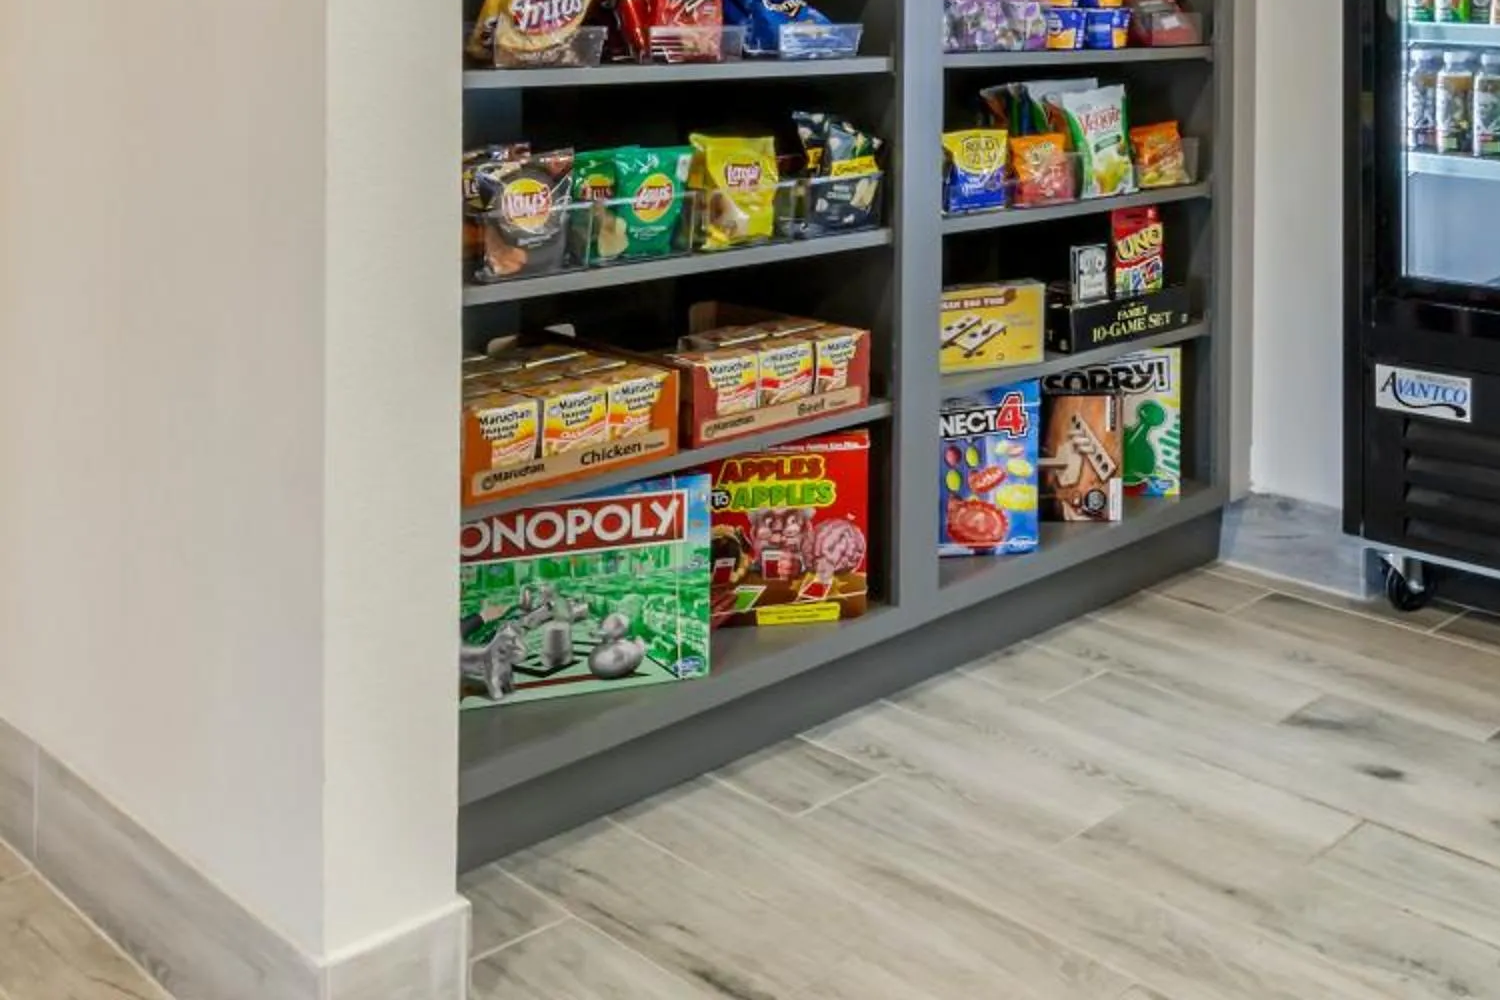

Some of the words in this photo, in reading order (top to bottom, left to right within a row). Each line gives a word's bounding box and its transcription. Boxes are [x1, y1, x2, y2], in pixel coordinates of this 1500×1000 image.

[1117, 226, 1161, 260] UNO
[1093, 317, 1147, 343] 10-GAME
[1148, 311, 1173, 329] SET
[1044, 358, 1170, 394] SORRY!
[1381, 371, 1468, 407] AVANTCO
[940, 407, 998, 438] NECT
[997, 395, 1026, 437] 4
[580, 441, 642, 466] Chicken
[721, 456, 825, 482] APPLES
[492, 462, 545, 484] Maruchan
[731, 482, 835, 509] APPLES
[461, 498, 680, 557] ONOPOLY
